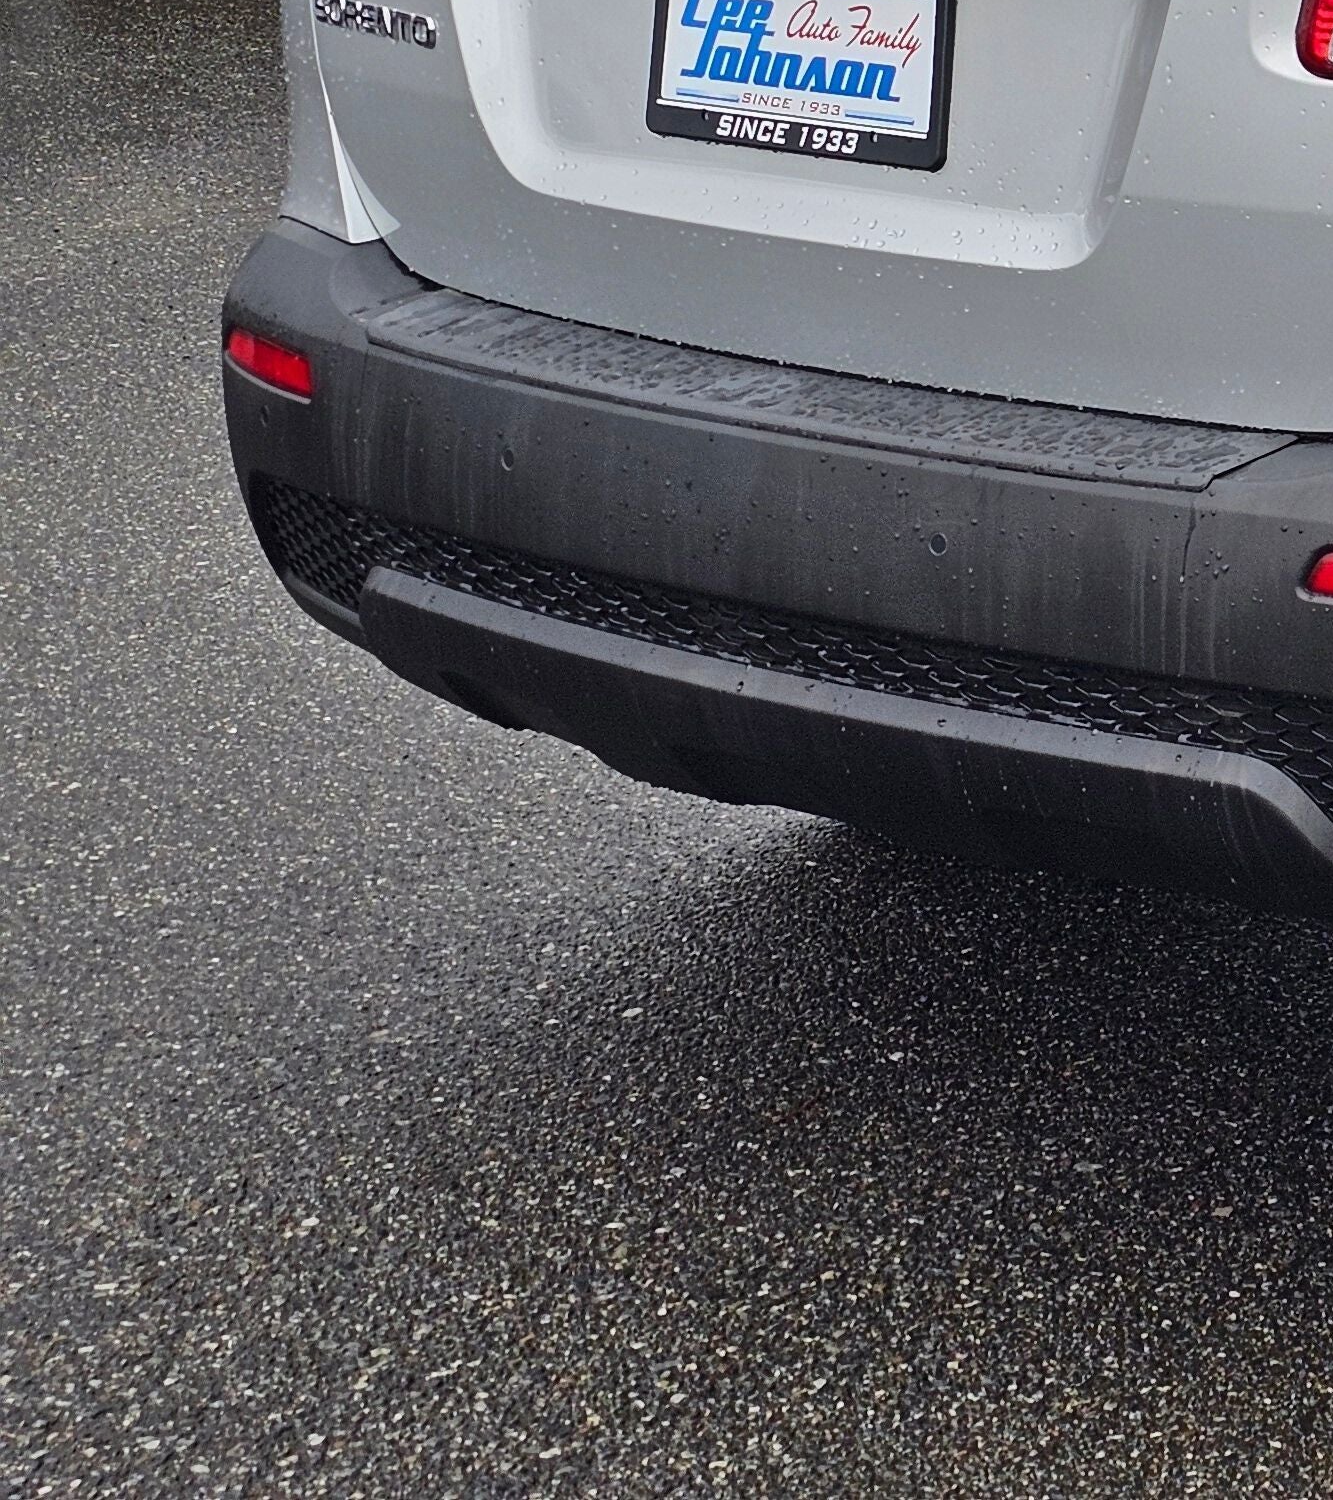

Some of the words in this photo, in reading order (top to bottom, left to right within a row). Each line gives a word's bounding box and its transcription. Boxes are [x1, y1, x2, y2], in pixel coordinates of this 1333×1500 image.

[786, 0, 841, 42] Auto
[846, 5, 922, 68] Family
[680, 27, 901, 103] Johnson
[741, 92, 793, 110] SINCE
[799, 96, 841, 117] 1933
[715, 114, 791, 145] SINCE
[797, 124, 860, 155] 1933
